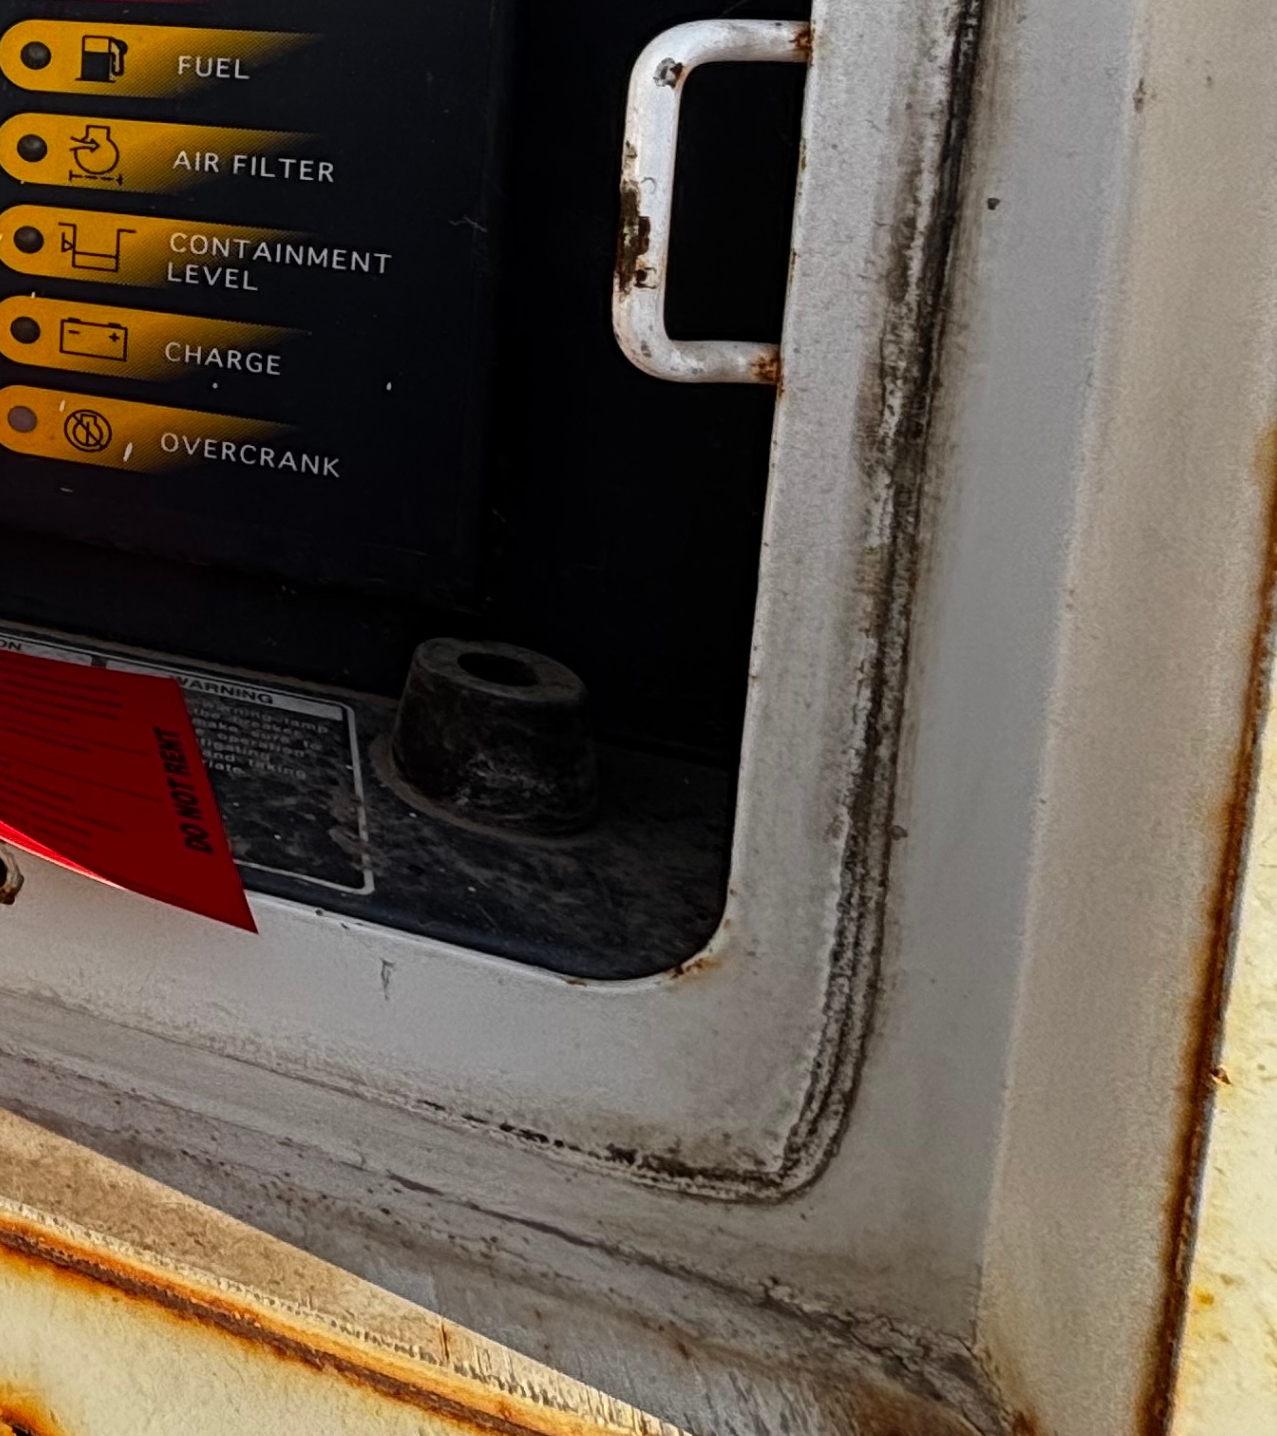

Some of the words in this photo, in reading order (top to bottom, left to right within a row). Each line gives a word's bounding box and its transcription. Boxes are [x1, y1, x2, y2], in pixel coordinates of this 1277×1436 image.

[177, 56, 250, 80] FUEL
[172, 151, 220, 173] AIR
[233, 155, 335, 183] FILTER
[170, 232, 392, 275] CONTAINMENT
[167, 262, 259, 291] LEVEL
[165, 342, 282, 376] CHARGE
[160, 432, 340, 478] OVERCRANK
[154, 727, 191, 777] RENT
[167, 777, 202, 821] NOT
[180, 823, 214, 854] DO
